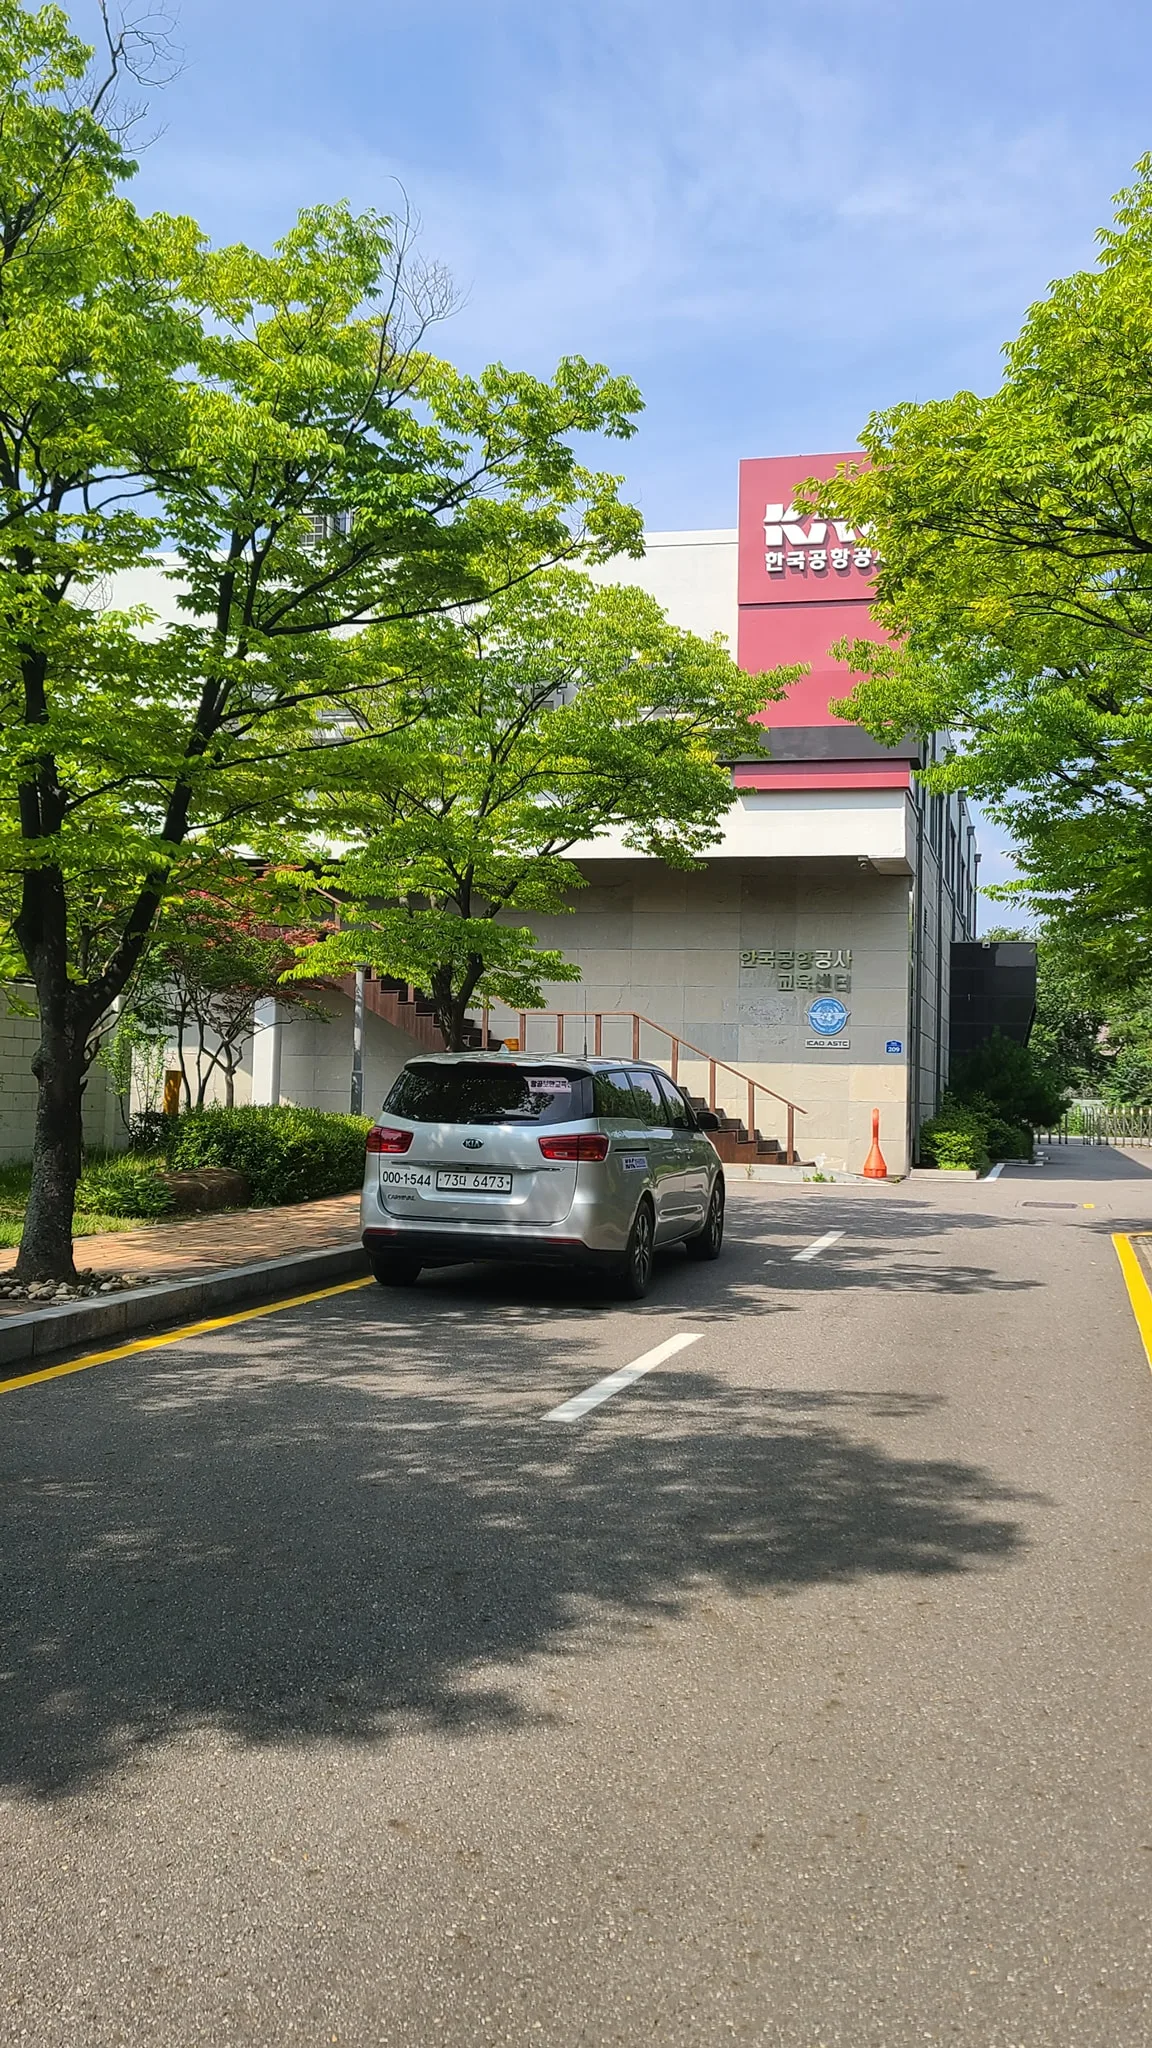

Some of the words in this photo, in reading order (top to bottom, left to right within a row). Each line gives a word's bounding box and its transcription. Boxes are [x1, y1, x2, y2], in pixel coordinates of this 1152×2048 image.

[763, 501, 879, 546] KA
[739, 949, 853, 970] 한국공항공사
[777, 973, 851, 993] 교육센터
[465, 1140, 480, 1149] KIA
[382, 1171, 431, 1186] 000-1-544
[472, 1175, 505, 1189] 6473
